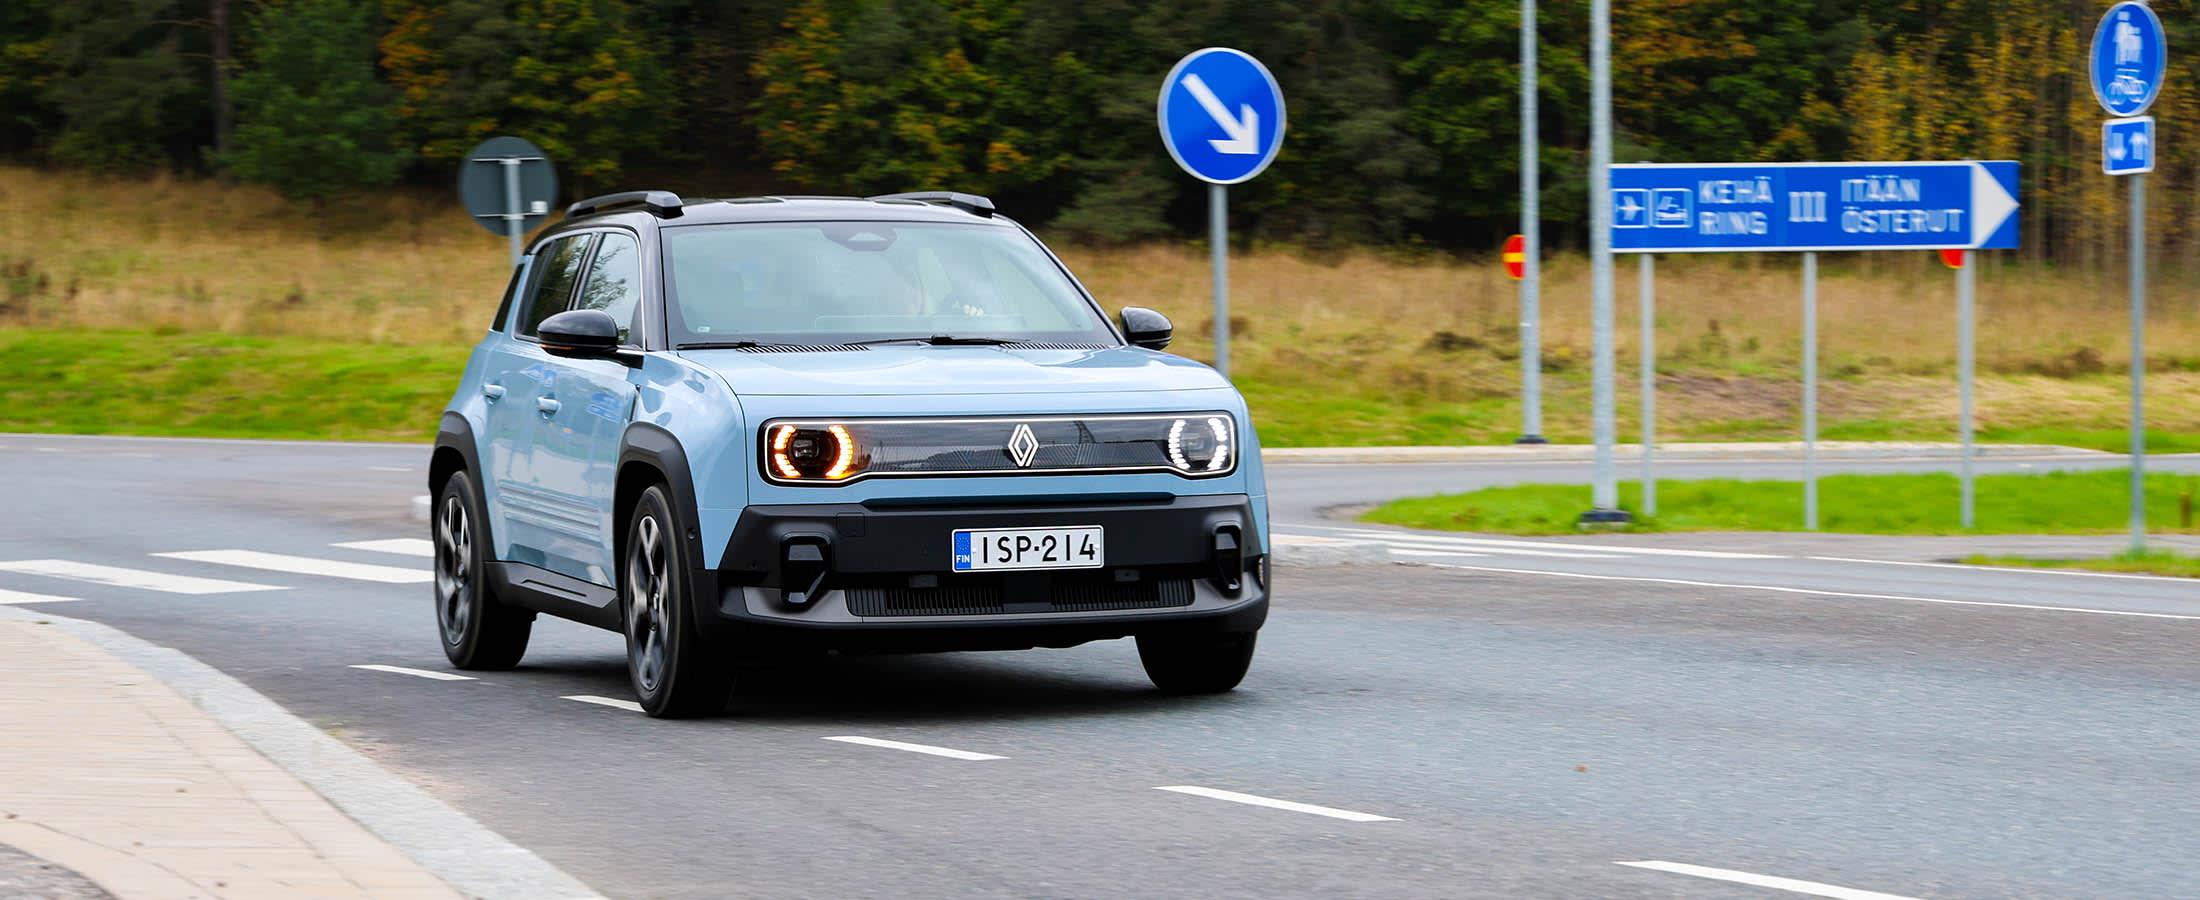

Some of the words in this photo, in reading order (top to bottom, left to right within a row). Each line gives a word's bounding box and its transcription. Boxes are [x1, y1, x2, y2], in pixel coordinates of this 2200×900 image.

[1699, 176, 1774, 203] KEHÄ
[1840, 175, 1920, 202] ITÄÄN
[1788, 191, 1827, 222] III
[1841, 206, 1964, 233] ÖSTERUT
[1699, 211, 1768, 235] RING
[956, 554, 970, 563] FIN
[982, 533, 1096, 564] ISP-214
